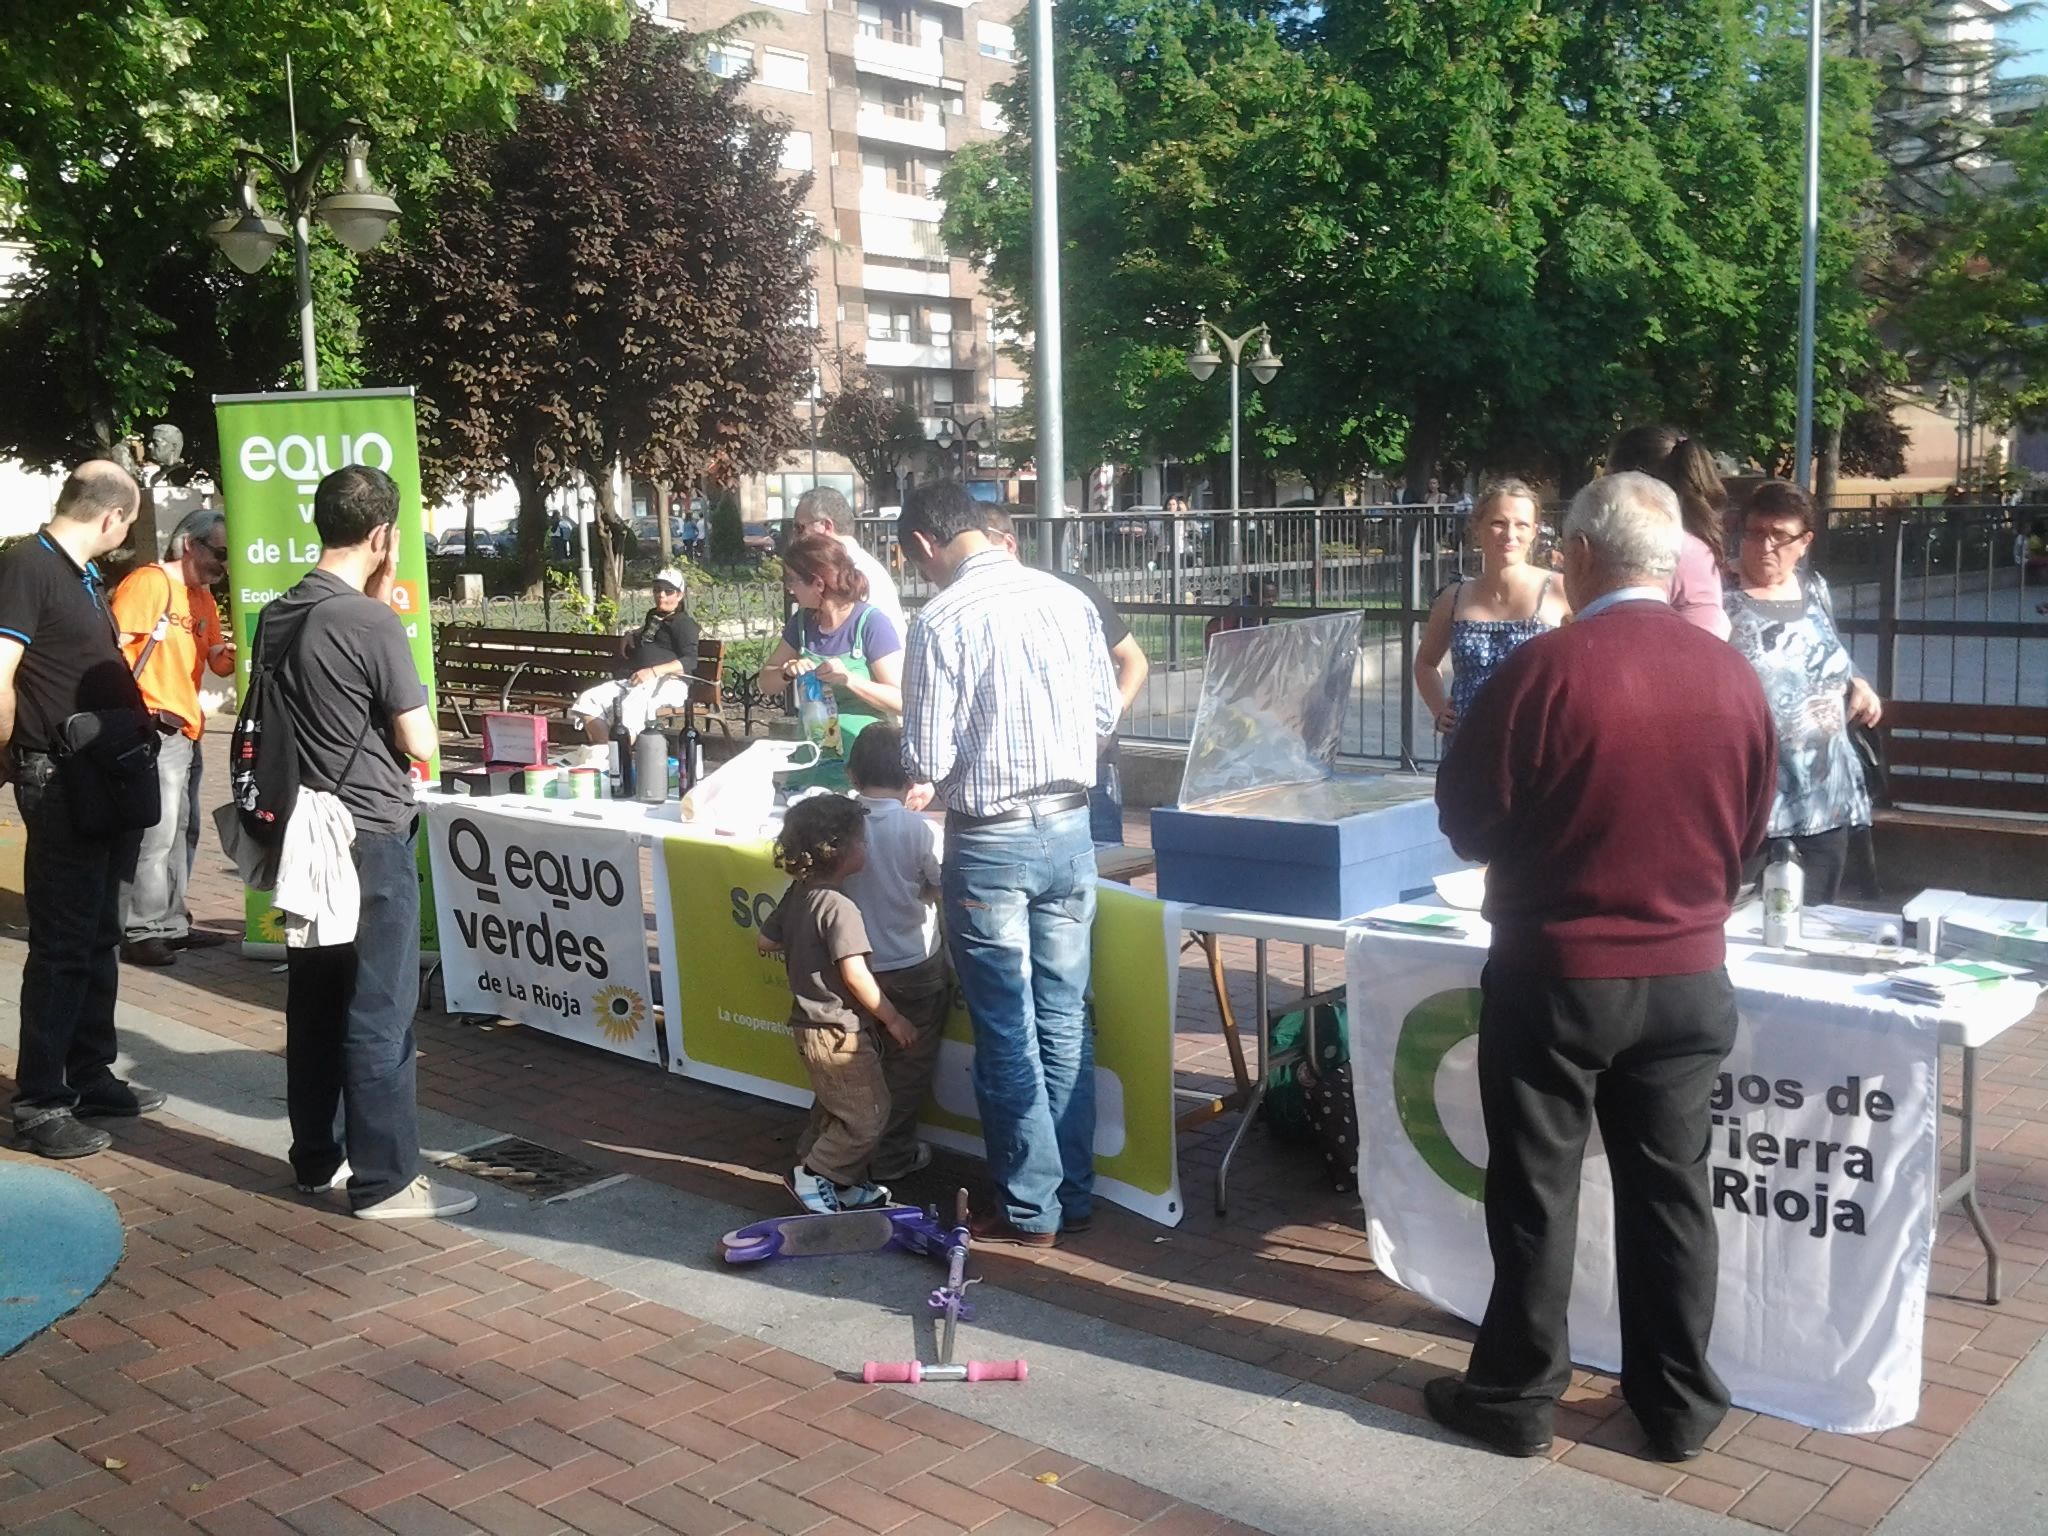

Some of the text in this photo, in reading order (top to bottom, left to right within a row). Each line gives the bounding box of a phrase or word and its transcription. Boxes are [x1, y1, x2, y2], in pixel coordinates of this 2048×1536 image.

[247, 539, 280, 564] de
[453, 908, 609, 980] verdes
[477, 970, 581, 1018] de La Rioja
[717, 1006, 730, 1021] La
[1710, 1071, 1895, 1122] gos de
[1711, 1114, 1874, 1183] ierra
[1712, 1166, 1867, 1238] Rioja
